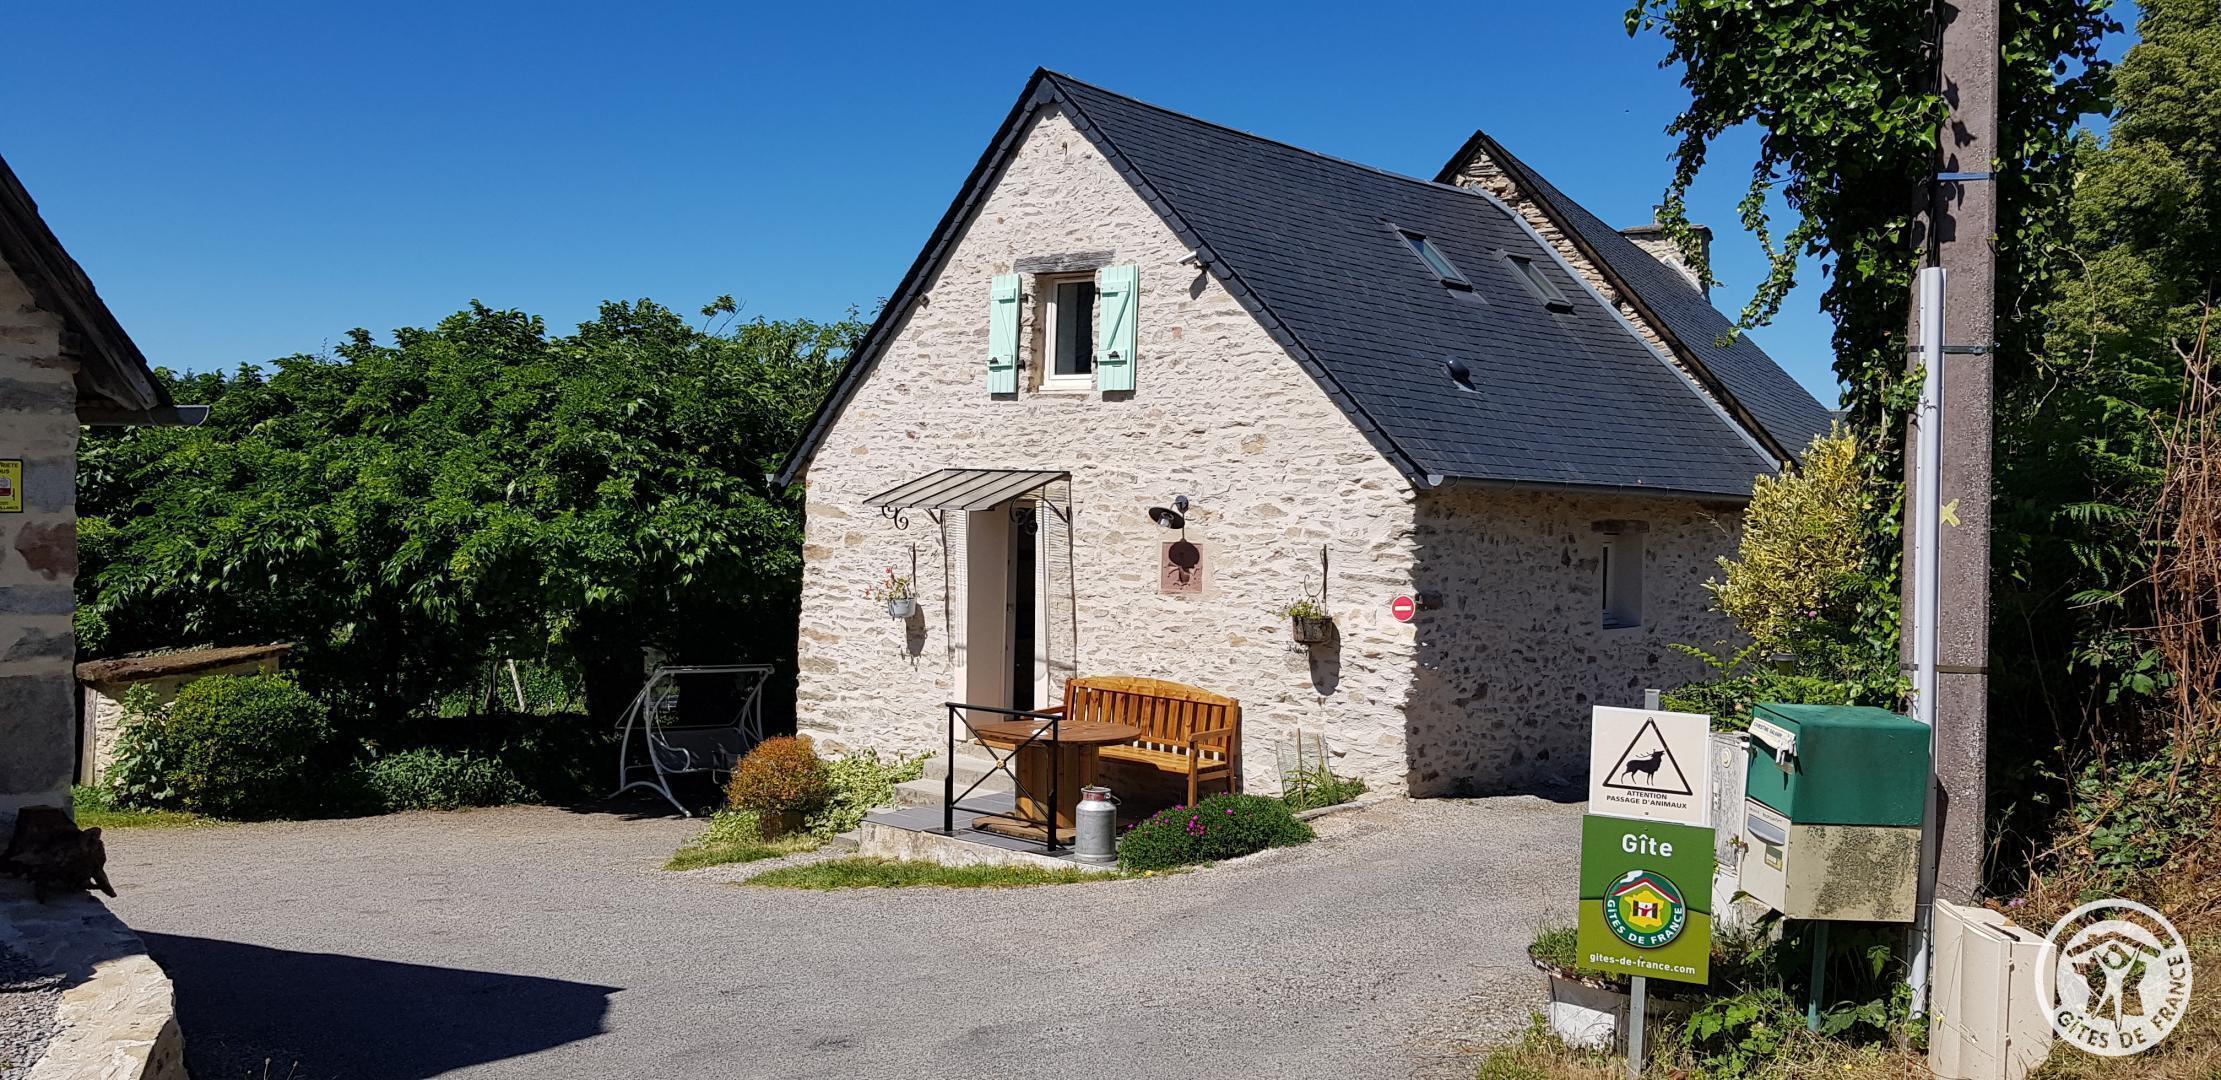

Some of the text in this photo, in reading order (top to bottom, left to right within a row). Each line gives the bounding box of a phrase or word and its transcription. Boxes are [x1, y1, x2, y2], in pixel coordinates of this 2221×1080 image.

[1606, 795, 1687, 809] PASSAGE D'ANIMAUX
[1626, 790, 1668, 800] ATTENTION
[1622, 833, 1673, 857] Gîte
[1627, 932, 1645, 944] DE
[1650, 907, 1683, 945] FRANCE
[1589, 952, 1696, 975] gites-de-france.com
